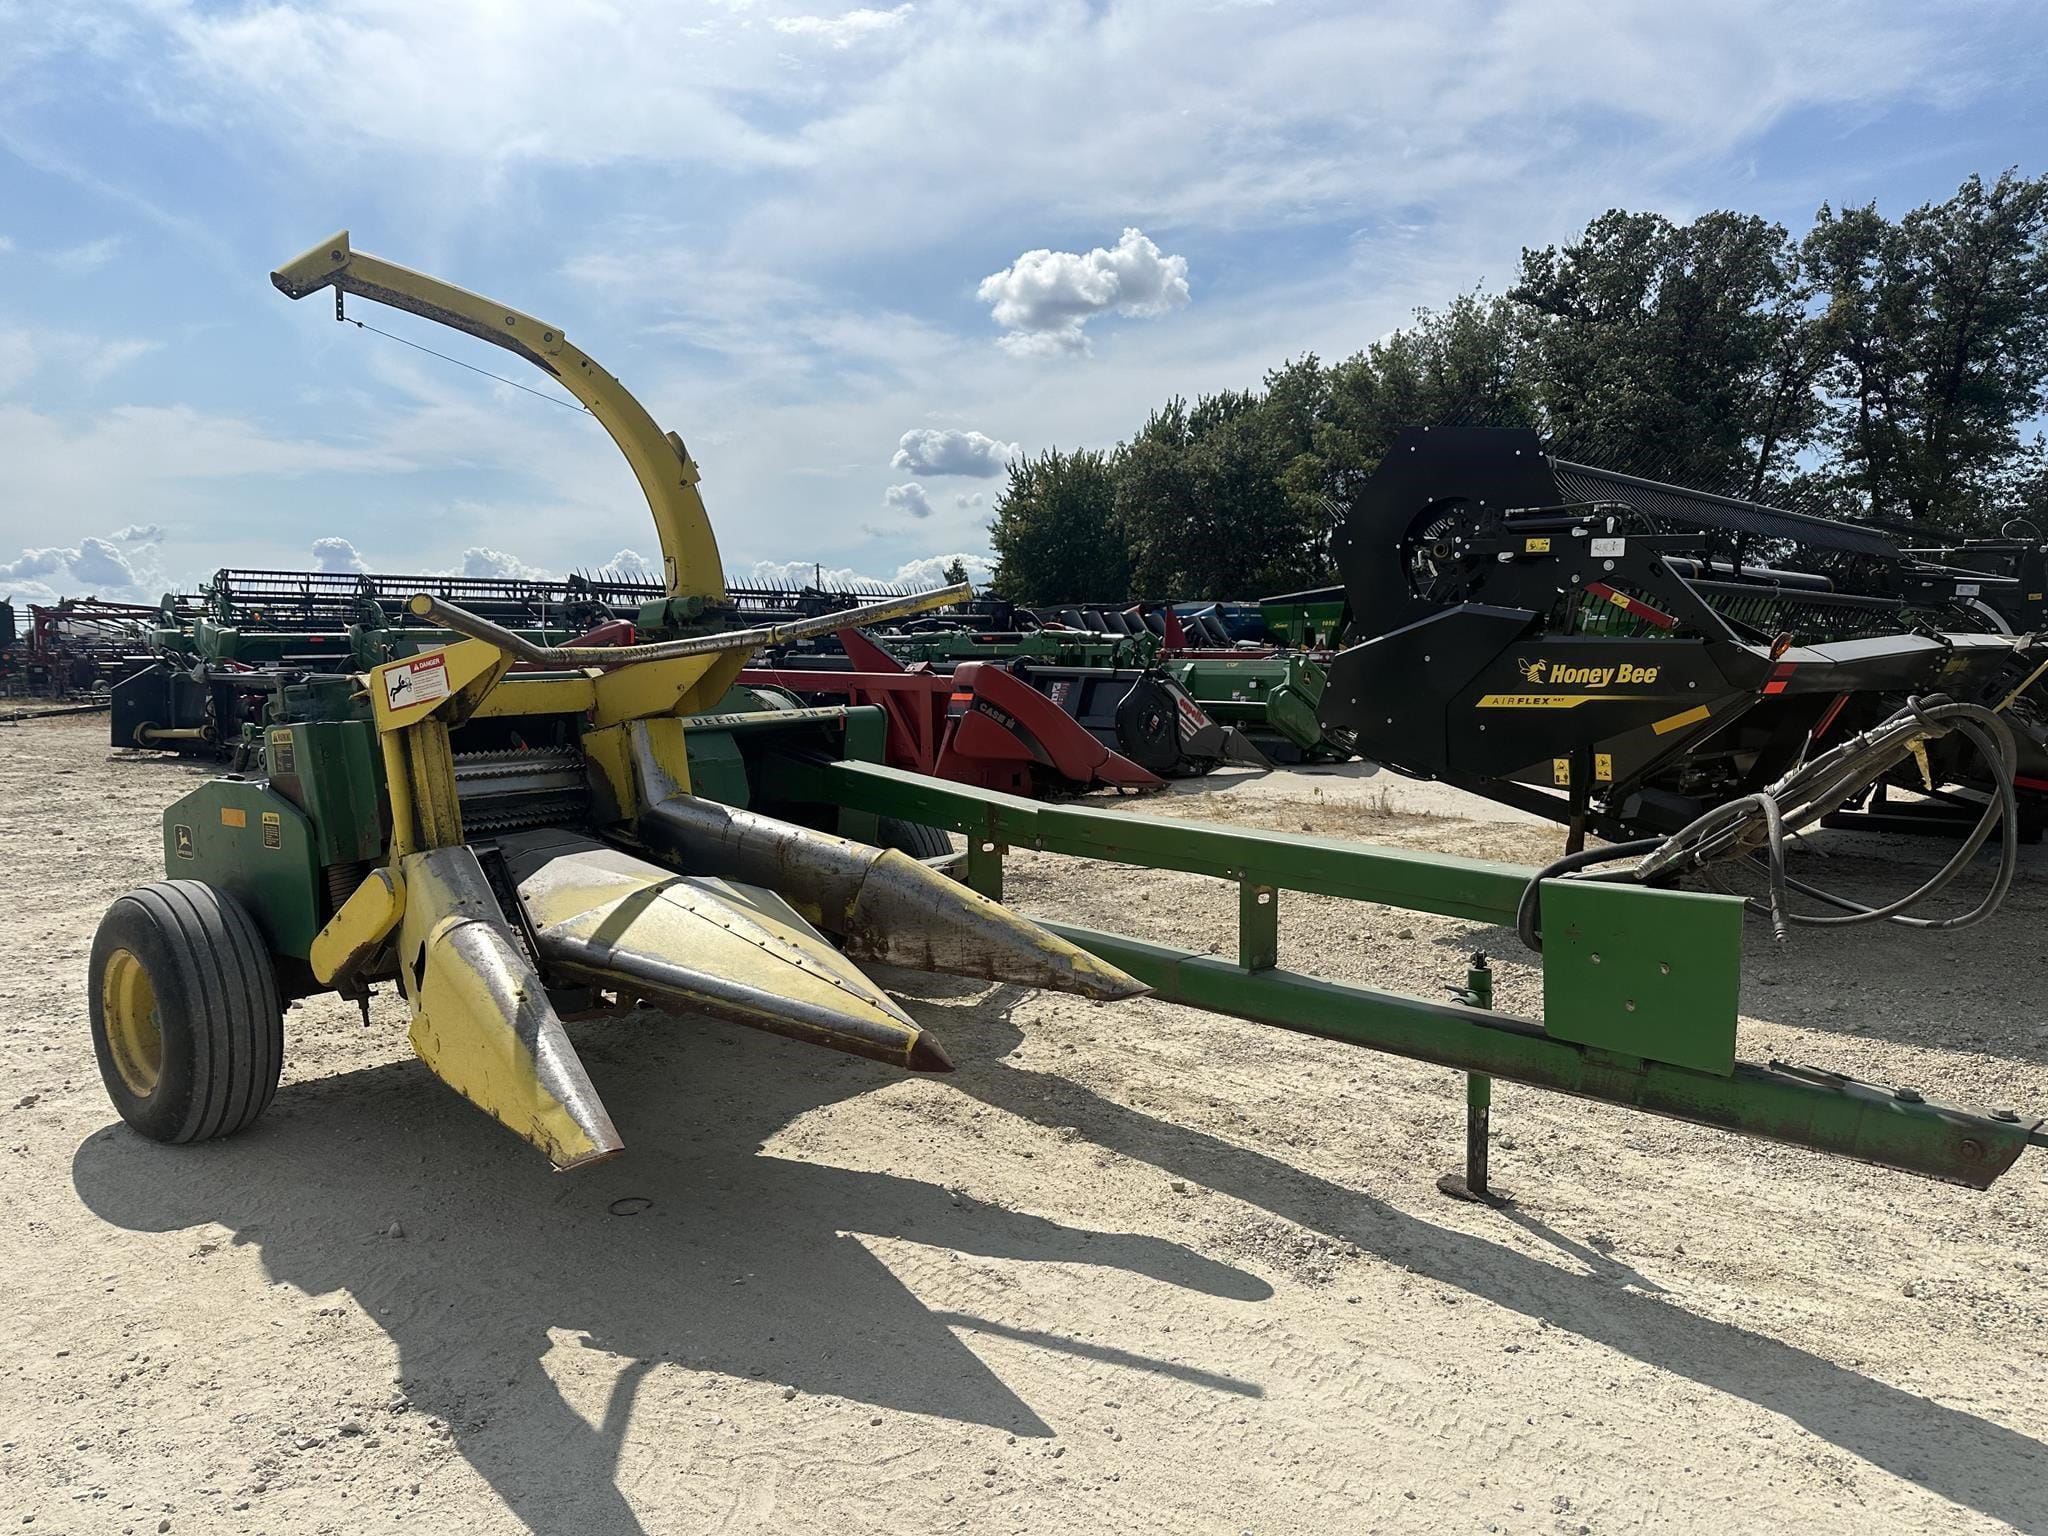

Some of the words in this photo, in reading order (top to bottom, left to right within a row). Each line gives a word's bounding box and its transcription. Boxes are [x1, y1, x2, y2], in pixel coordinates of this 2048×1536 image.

[419, 657, 441, 669] DANGER
[1549, 664, 1616, 688] Honey
[1614, 663, 1658, 684] Bee
[1492, 697, 1550, 705] AIRFLEX
[979, 702, 1006, 724] CASE
[692, 715, 747, 727] DEERE
